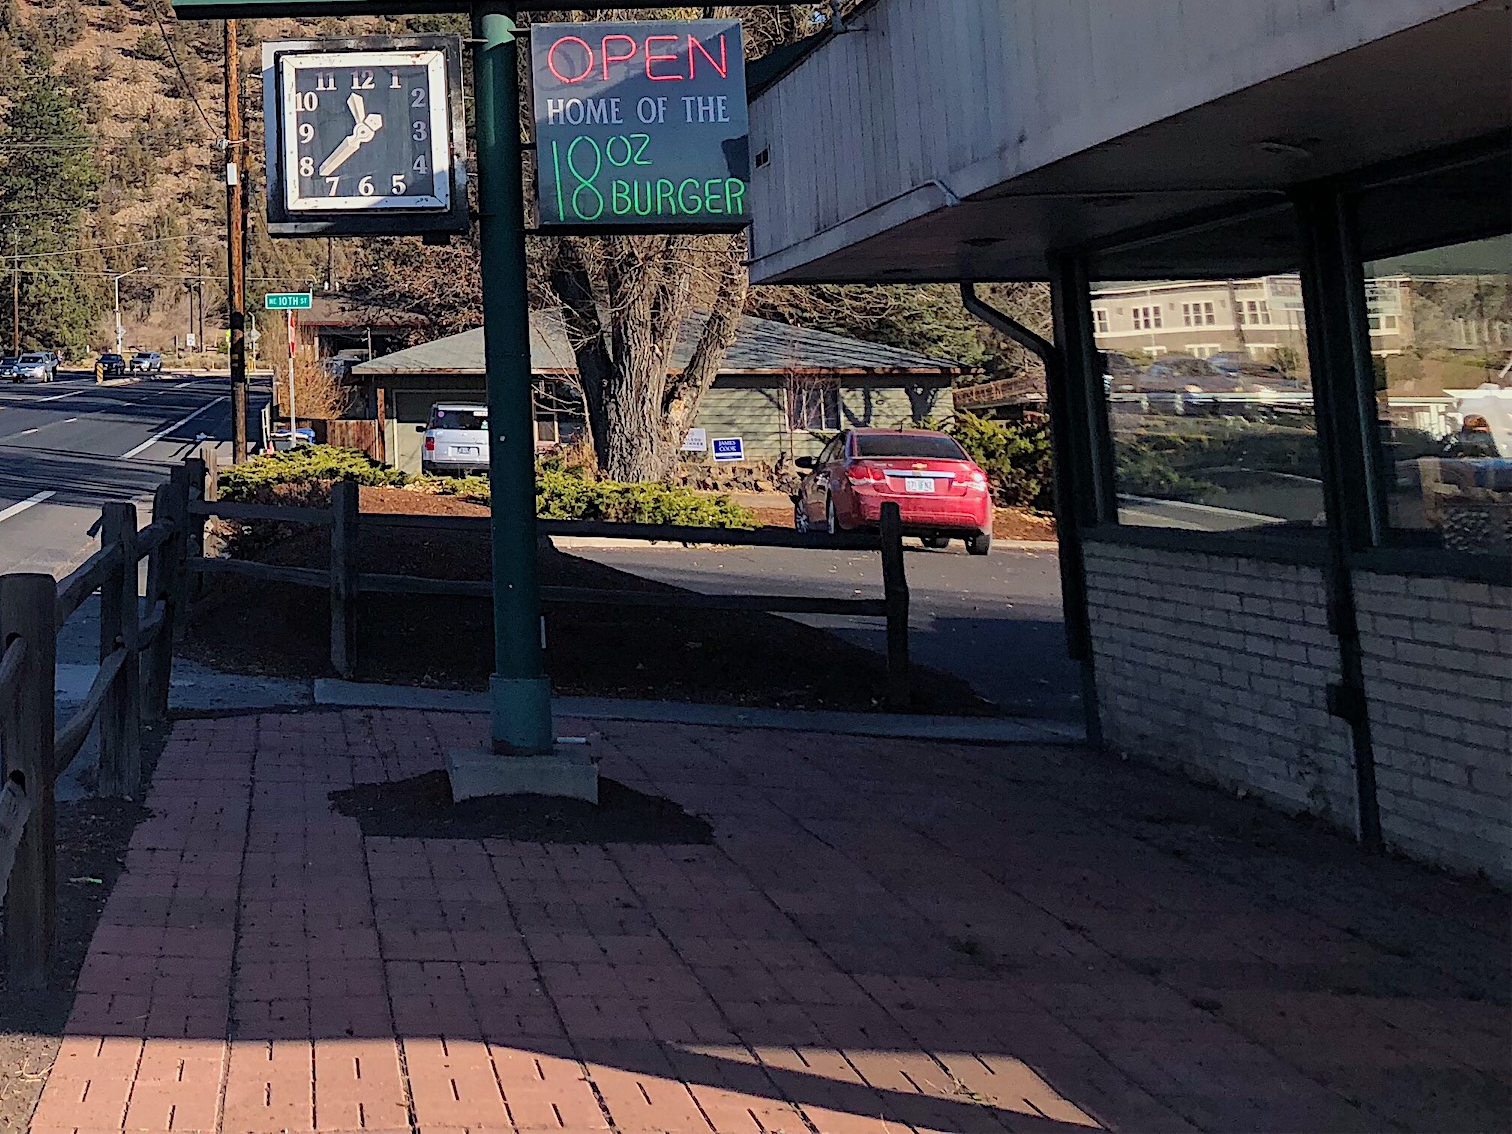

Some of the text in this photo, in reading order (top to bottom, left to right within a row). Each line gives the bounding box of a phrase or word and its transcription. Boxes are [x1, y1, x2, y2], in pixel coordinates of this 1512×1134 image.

[547, 34, 728, 83] OPEN
[315, 69, 402, 91] 11 12 1
[295, 91, 319, 112] 10
[411, 88, 426, 108] 2
[547, 95, 730, 125] HOME OF THE
[299, 123, 315, 144] 9
[412, 121, 428, 141] 3
[299, 156, 315, 177] 8
[412, 154, 428, 175] 4
[326, 176, 340, 196] 7
[358, 176, 375, 196] 6
[391, 174, 406, 195] 5
[612, 177, 746, 216] BURGER
[278, 296, 299, 306] 10TH
[300, 297, 307, 305] ST
